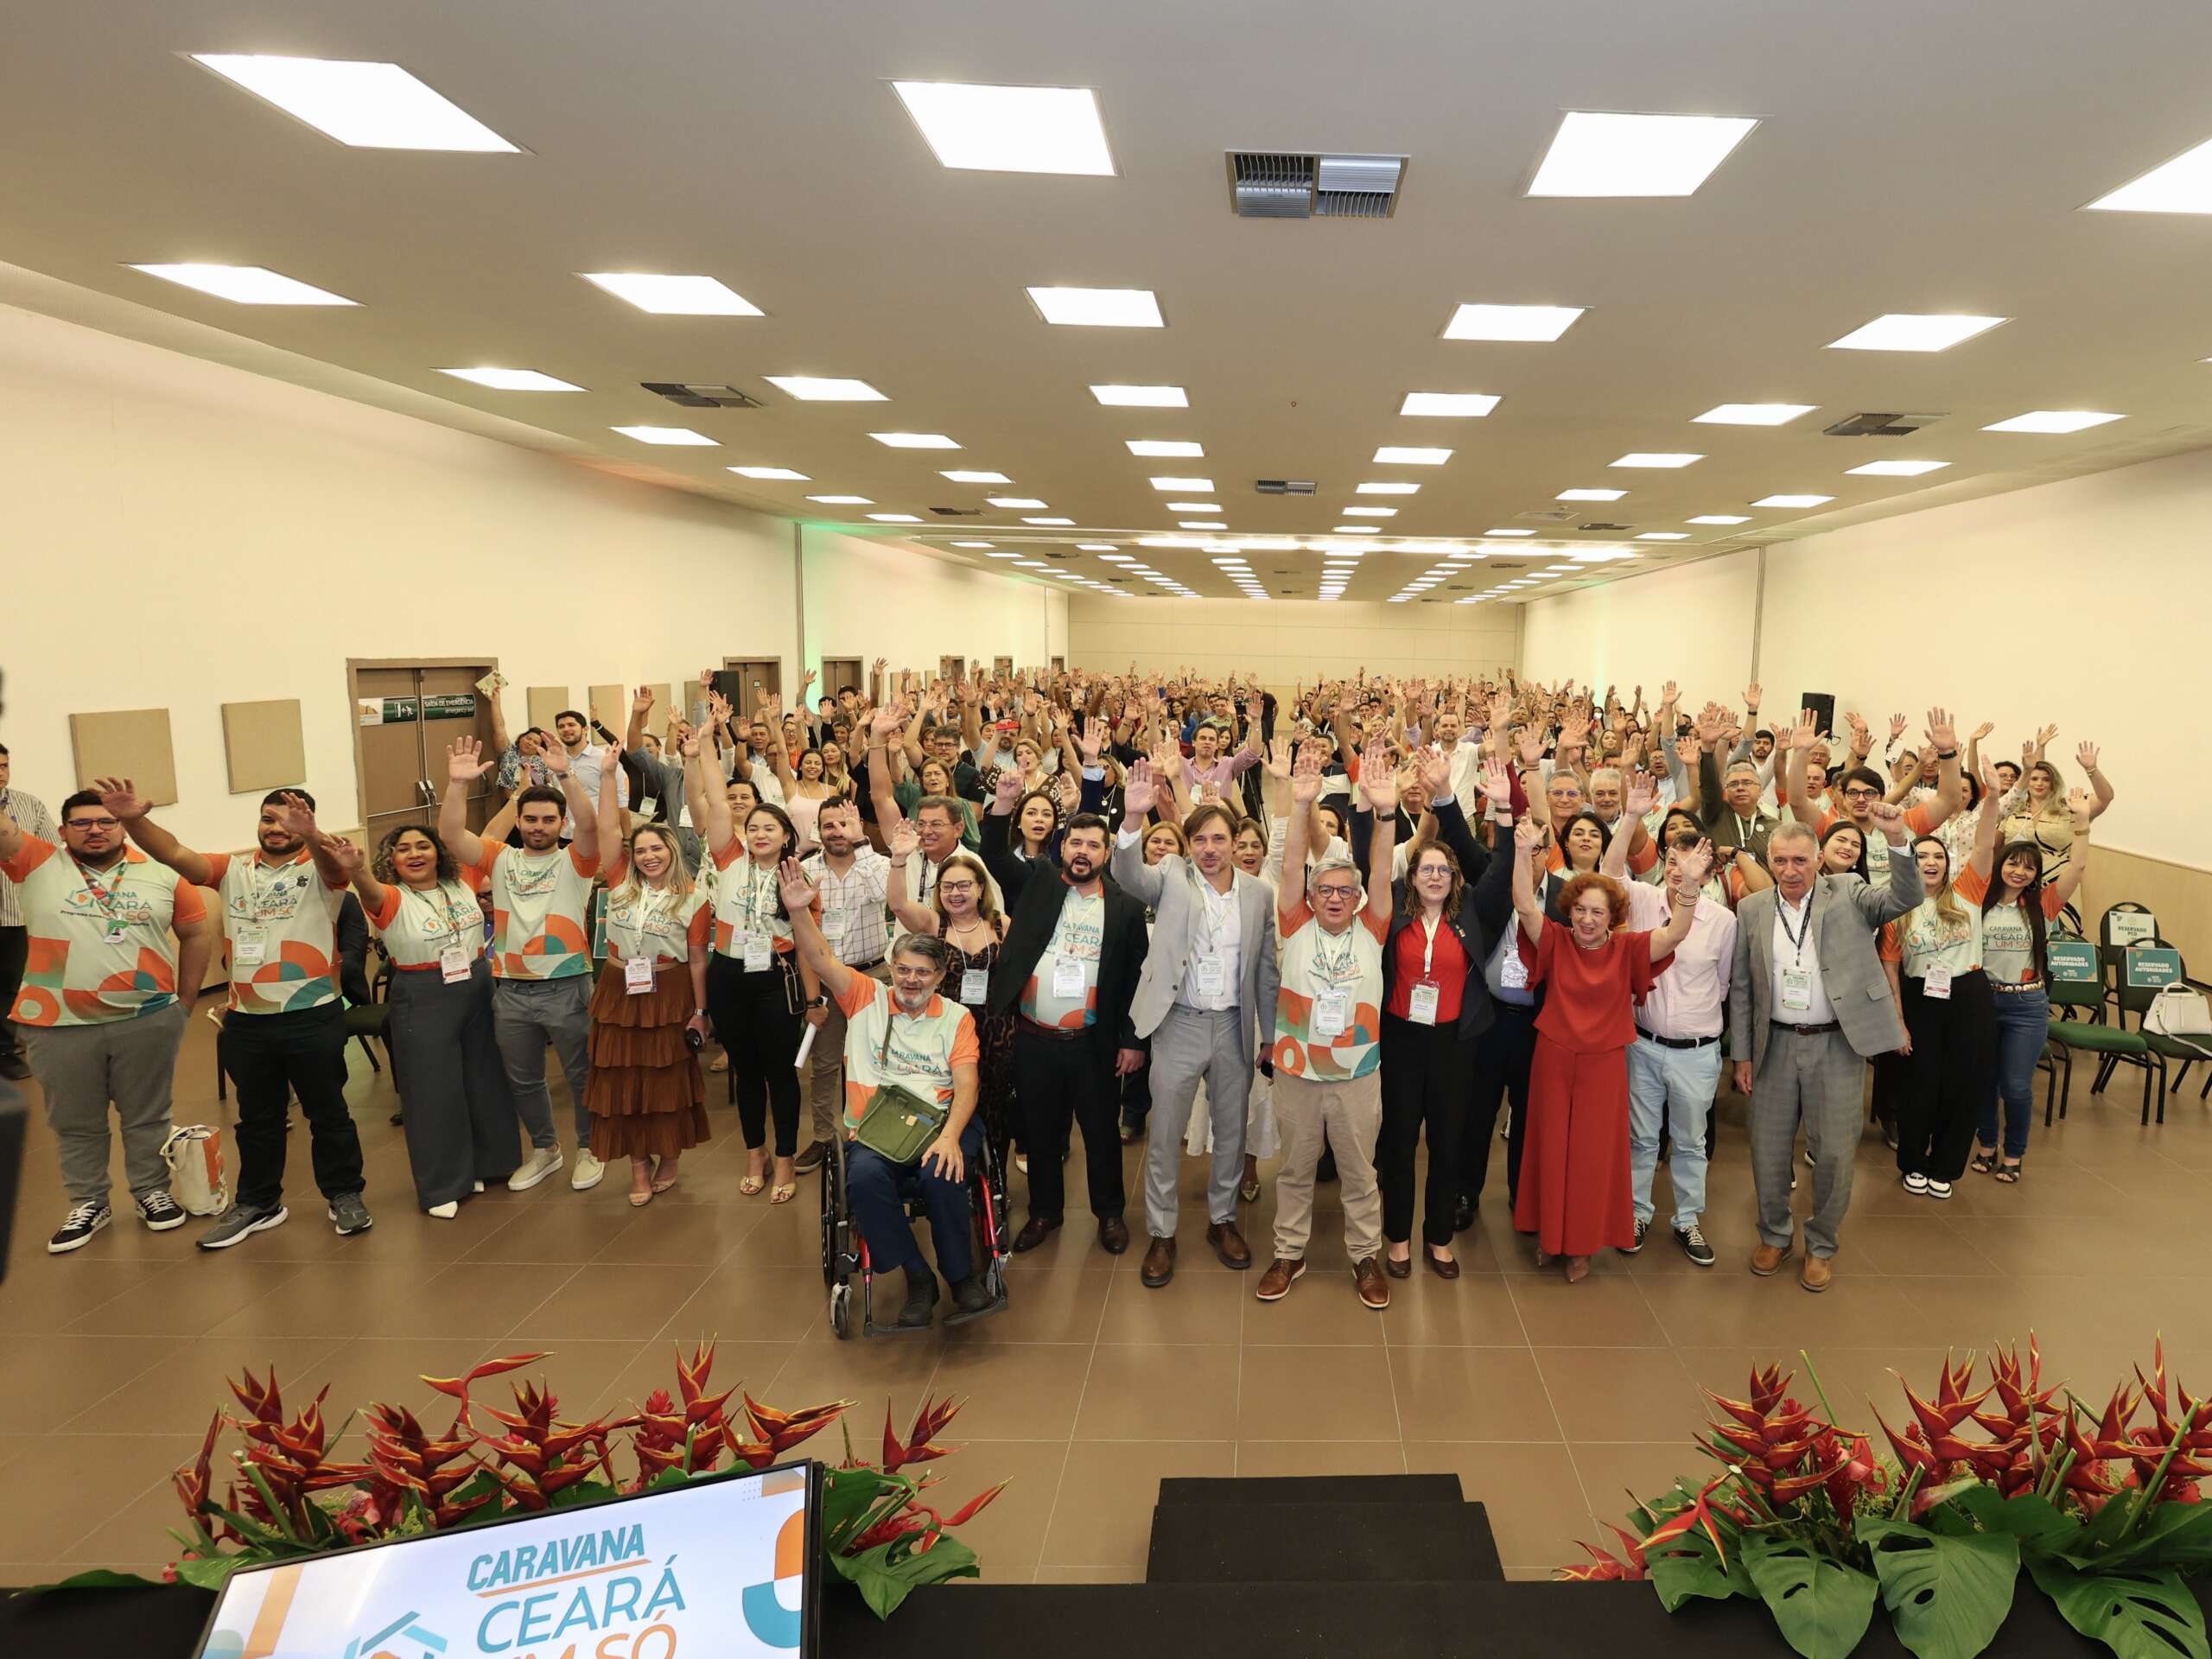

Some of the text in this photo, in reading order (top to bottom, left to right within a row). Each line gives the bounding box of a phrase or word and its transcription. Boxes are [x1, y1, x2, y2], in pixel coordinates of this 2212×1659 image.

[2118, 925, 2148, 934] RESERVADO
[467, 1523, 645, 1591] CARAVANA
[477, 1554, 686, 1653] CEARÁ
